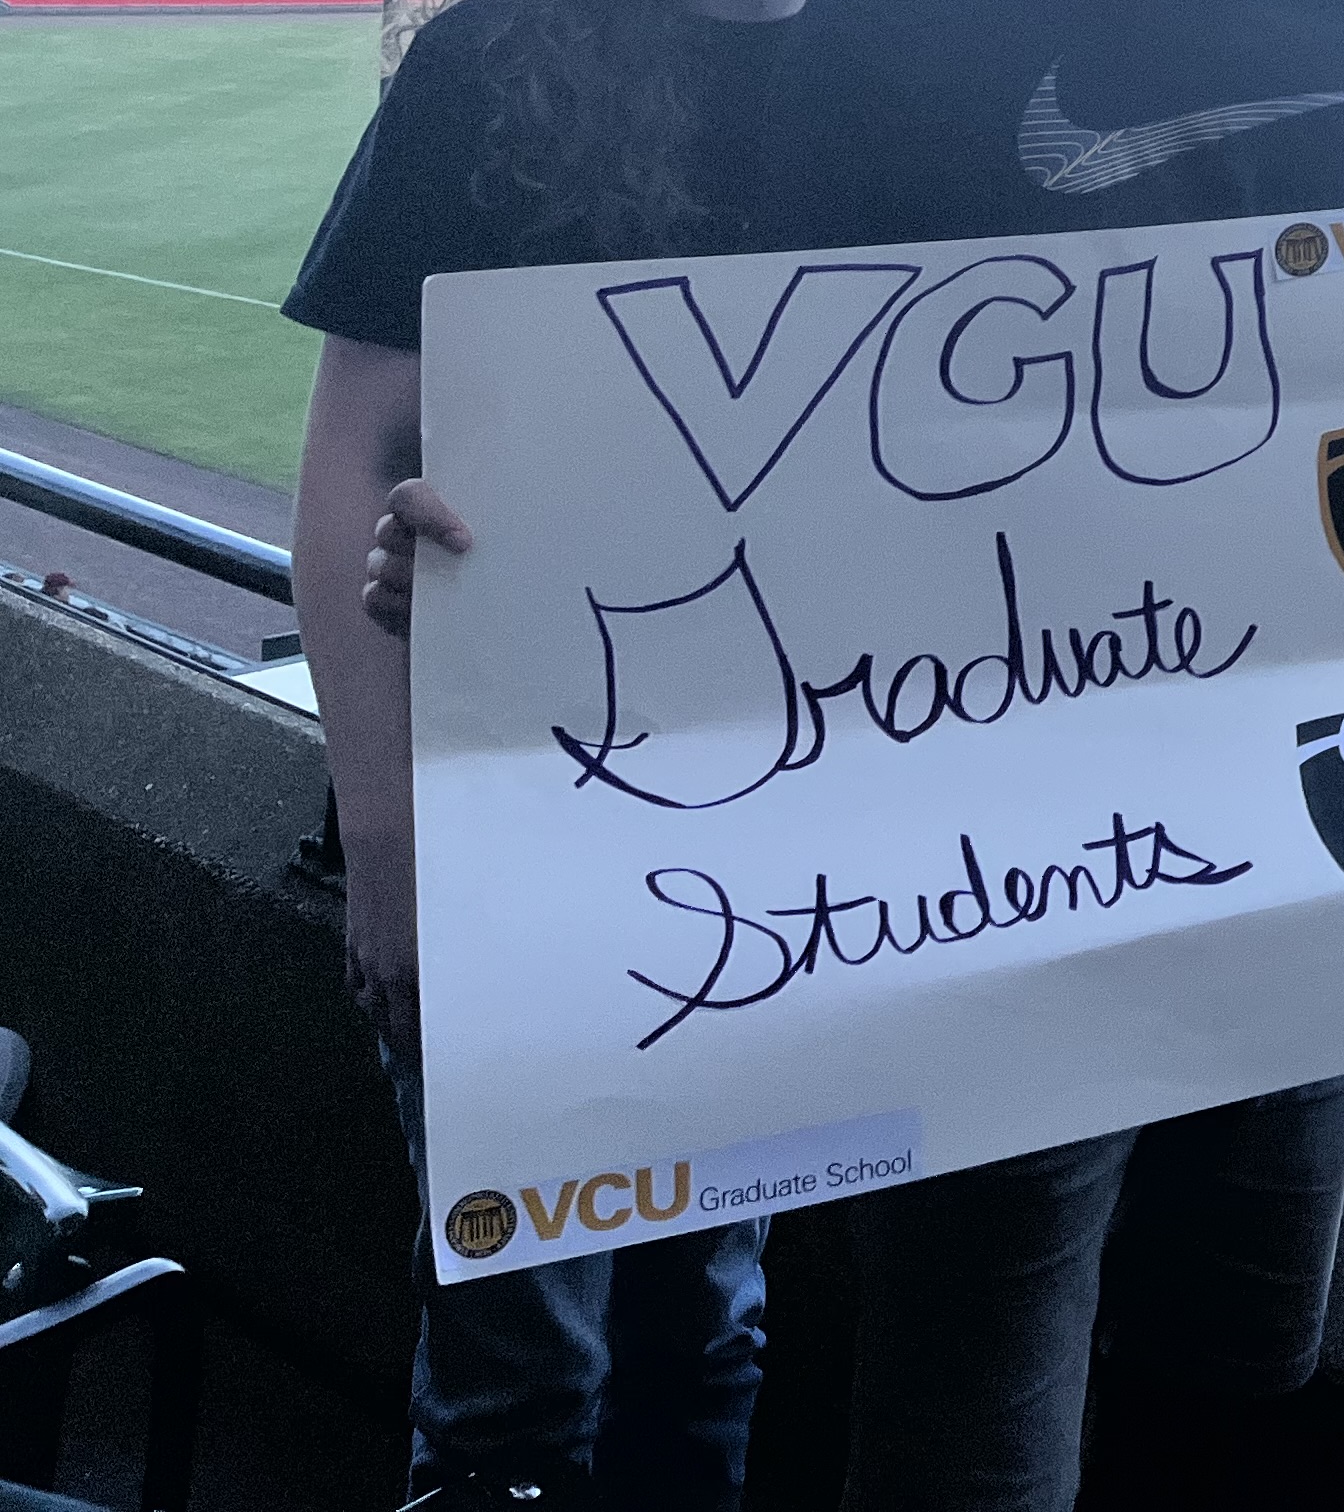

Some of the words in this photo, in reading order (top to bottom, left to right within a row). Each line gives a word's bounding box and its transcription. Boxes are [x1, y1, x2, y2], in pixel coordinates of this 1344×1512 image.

[552, 530, 1259, 810] Graduate
[626, 812, 1254, 1050] Students
[518, 1160, 692, 1242] VCU
[699, 1172, 818, 1213] Graduate
[826, 1148, 913, 1188] School
